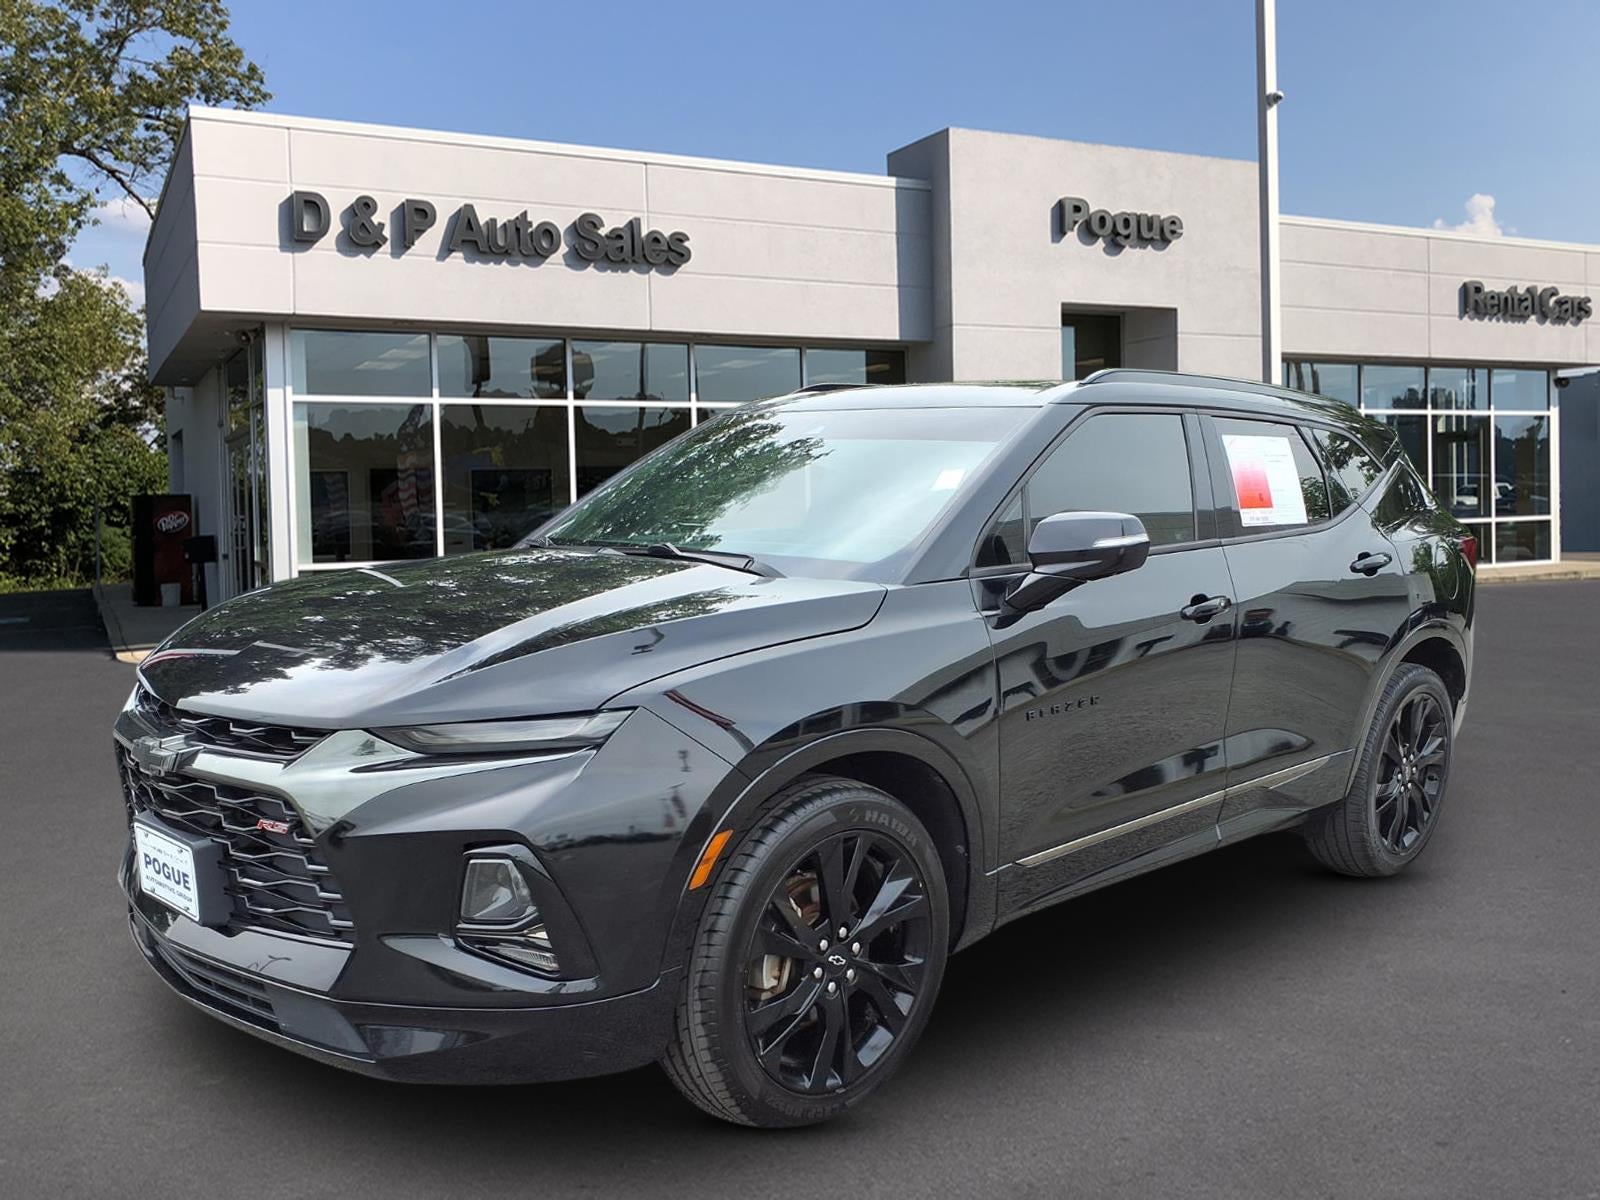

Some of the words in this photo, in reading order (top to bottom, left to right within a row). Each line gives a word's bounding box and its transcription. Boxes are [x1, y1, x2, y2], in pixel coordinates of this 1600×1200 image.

[293, 190, 331, 243] D
[349, 195, 388, 249] &
[402, 198, 437, 248] P
[449, 203, 562, 258] Auto
[573, 212, 692, 266] Sales
[1060, 197, 1184, 248] Pogue
[1463, 280, 1538, 318] Rental
[1538, 286, 1592, 321] Cars
[256, 819, 288, 835] RS
[143, 852, 191, 892] POGUE
